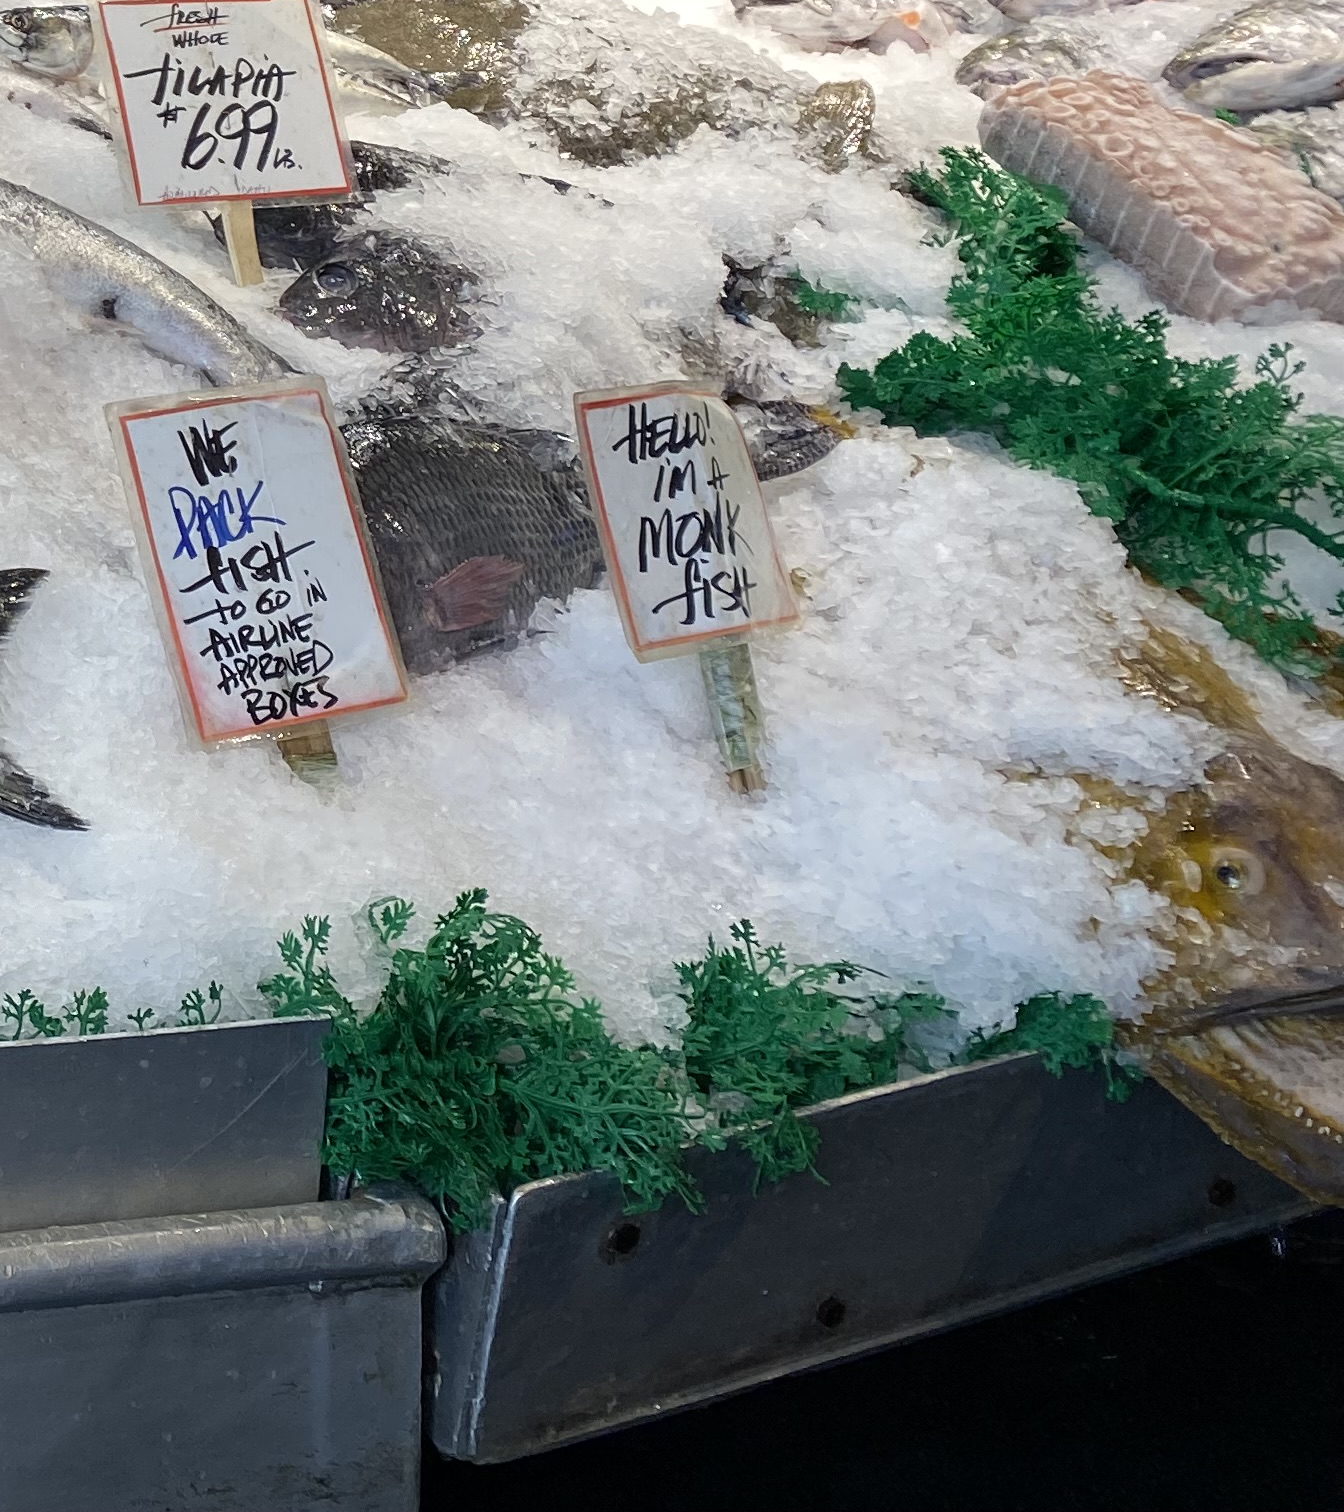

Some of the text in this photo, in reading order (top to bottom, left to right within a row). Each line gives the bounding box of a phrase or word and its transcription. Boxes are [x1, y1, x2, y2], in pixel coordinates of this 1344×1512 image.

[177, 418, 238, 486] WE
[168, 481, 287, 560] PACK
[638, 491, 754, 573] MONK
[256, 588, 292, 615] GO
[305, 570, 327, 608] IN
[200, 613, 313, 662] AIRLINE
[217, 639, 334, 695] APPROVED
[241, 676, 339, 725] BOXES
